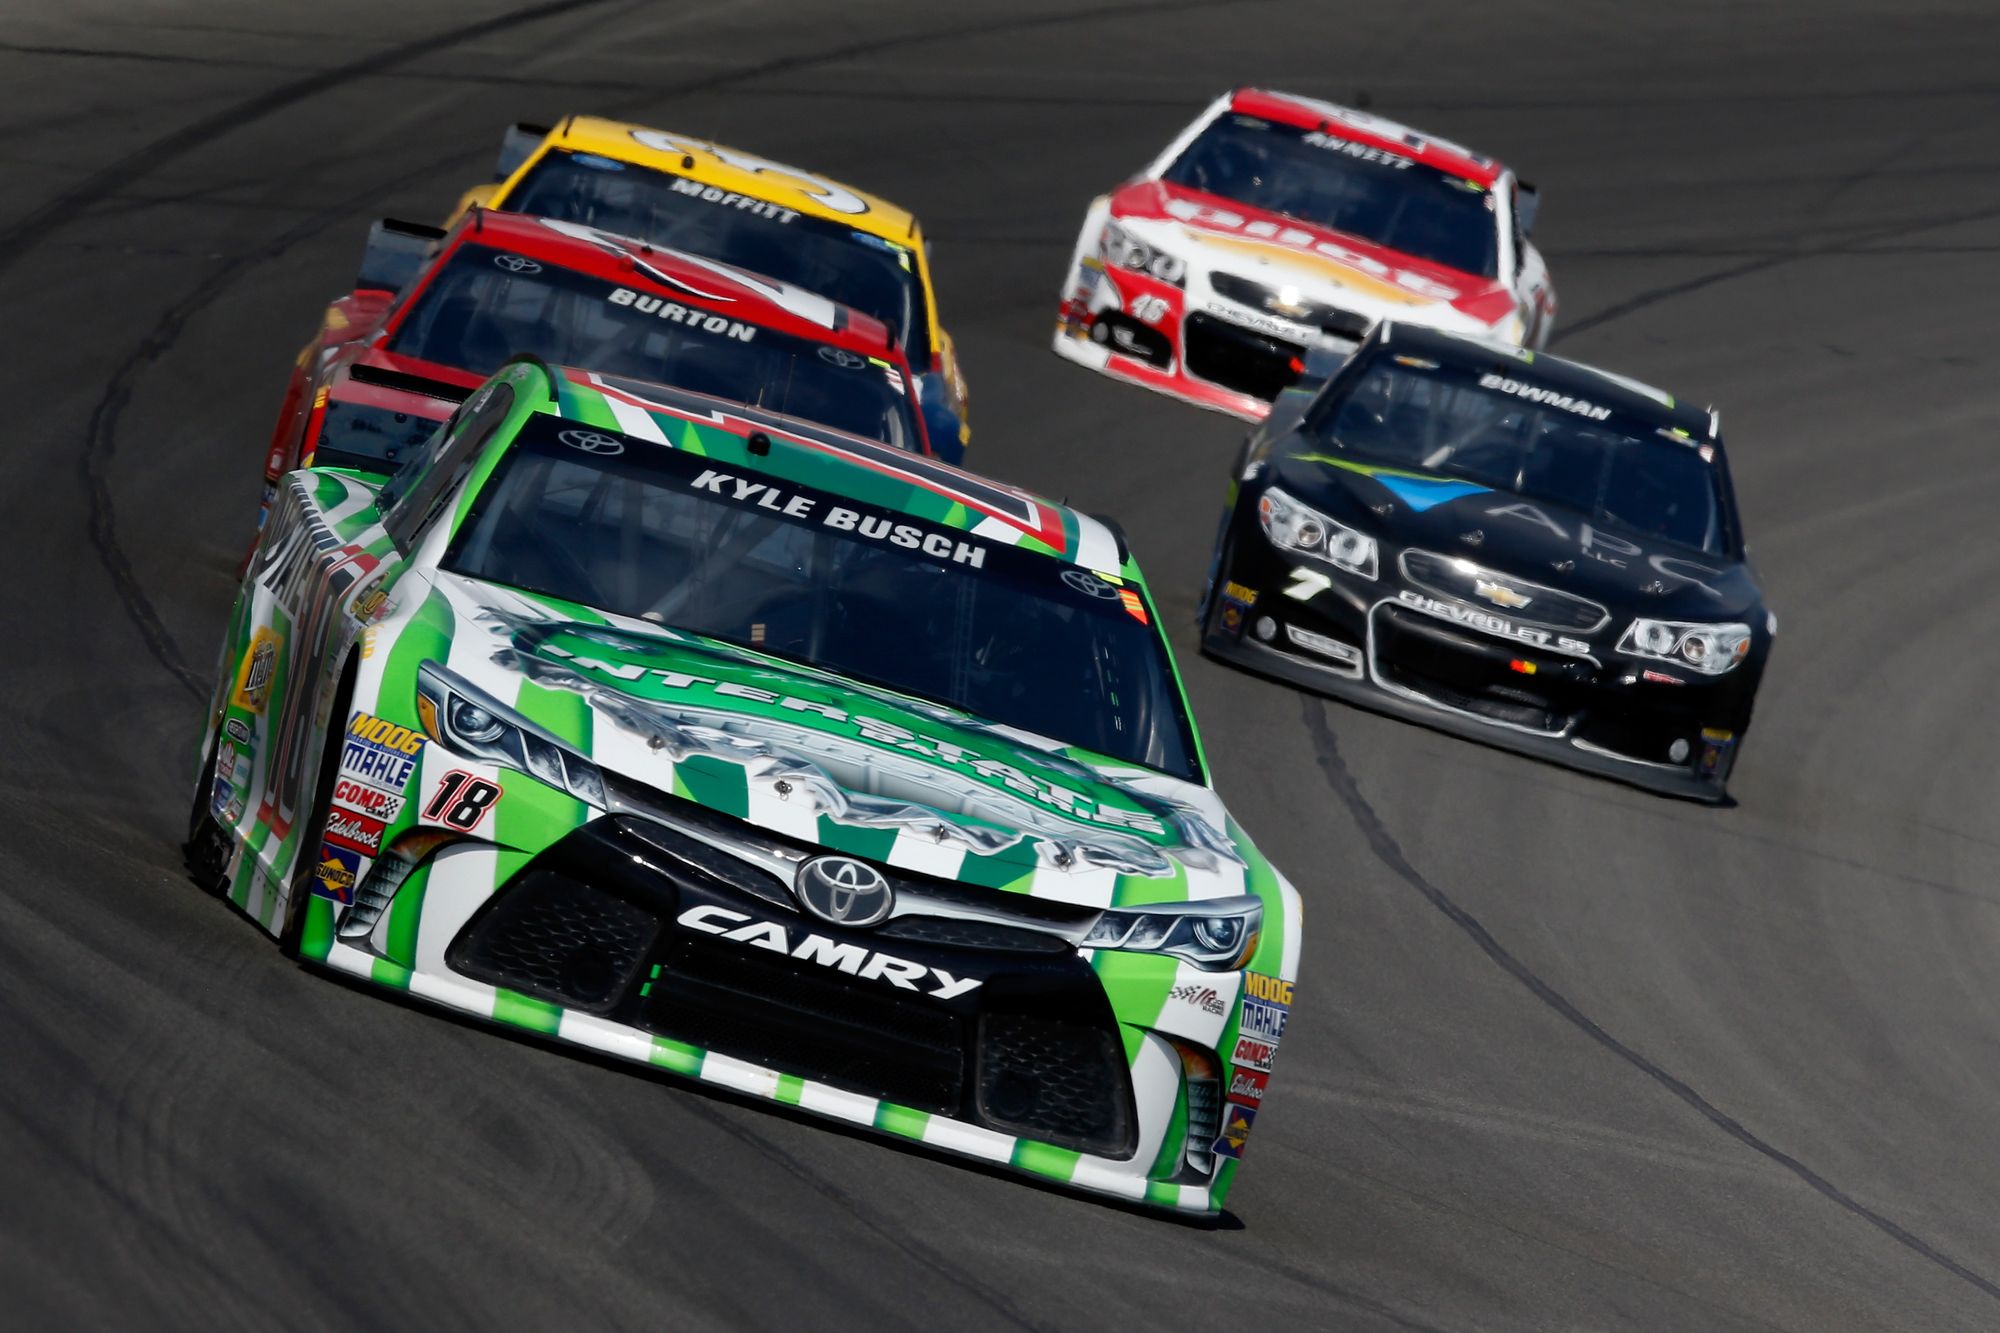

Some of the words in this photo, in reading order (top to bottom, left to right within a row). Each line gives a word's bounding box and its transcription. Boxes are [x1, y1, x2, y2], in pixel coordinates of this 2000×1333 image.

[1304, 132, 1414, 170] ANNETT
[669, 177, 800, 224] MOFFITT
[608, 287, 757, 342] BURTON
[1479, 372, 1611, 421] BOWMAN
[690, 469, 816, 519] KYLE
[823, 506, 986, 569] BUSCH
[1226, 580, 1259, 604] MOOG
[1283, 566, 1331, 600] 7
[1400, 590, 1552, 646] CHEVROLET
[1558, 637, 1590, 653] SS
[351, 712, 430, 757] MOOG
[536, 645, 1155, 824] INTERSTATE
[343, 742, 414, 789] MAHLE
[334, 779, 386, 810] COMP
[365, 806, 389, 819] CAMS
[421, 769, 504, 833] 18
[326, 812, 380, 849] Edelbrock
[315, 861, 354, 888] SUNOCO
[676, 904, 984, 999] CAMRY
[1244, 971, 1295, 1006] MOOG
[1240, 1001, 1288, 1037] MAHLE
[1234, 1039, 1268, 1062] COMP
